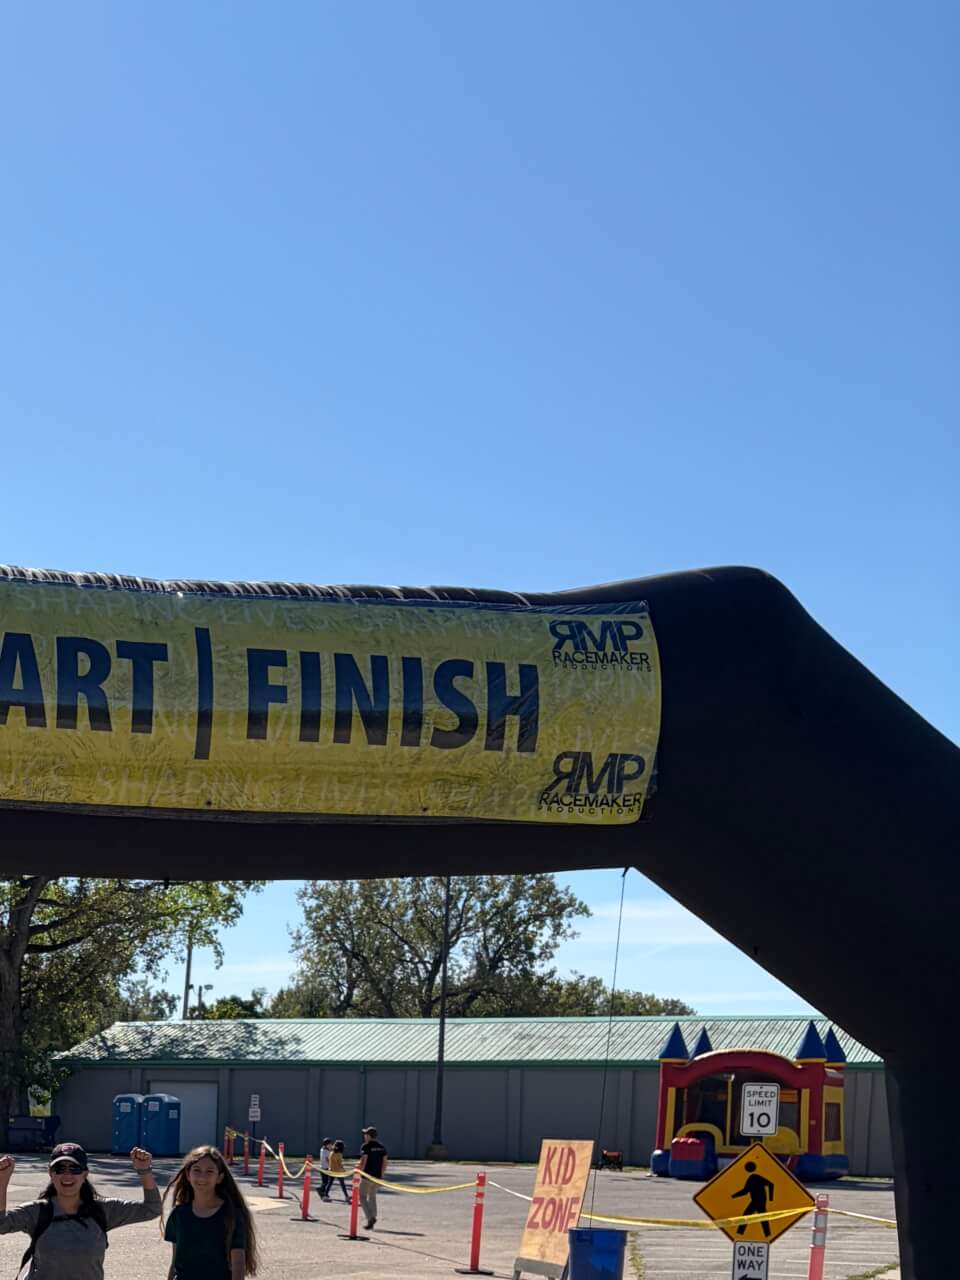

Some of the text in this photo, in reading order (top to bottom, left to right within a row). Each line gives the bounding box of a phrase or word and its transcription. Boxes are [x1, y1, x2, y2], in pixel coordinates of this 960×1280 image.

[552, 649, 649, 666] RACEMAKER
[553, 663, 652, 673] PRODUCTIONS
[246, 647, 539, 753] FINISH
[539, 791, 642, 808] RACEMAKER
[746, 1090, 777, 1099] SPEED
[748, 1099, 772, 1107] LIMIT
[748, 1112, 771, 1128] 10
[542, 1146, 576, 1185] KID
[526, 1196, 581, 1234] ZONE
[737, 1245, 765, 1257] ONE
[737, 1259, 765, 1271] WAY
